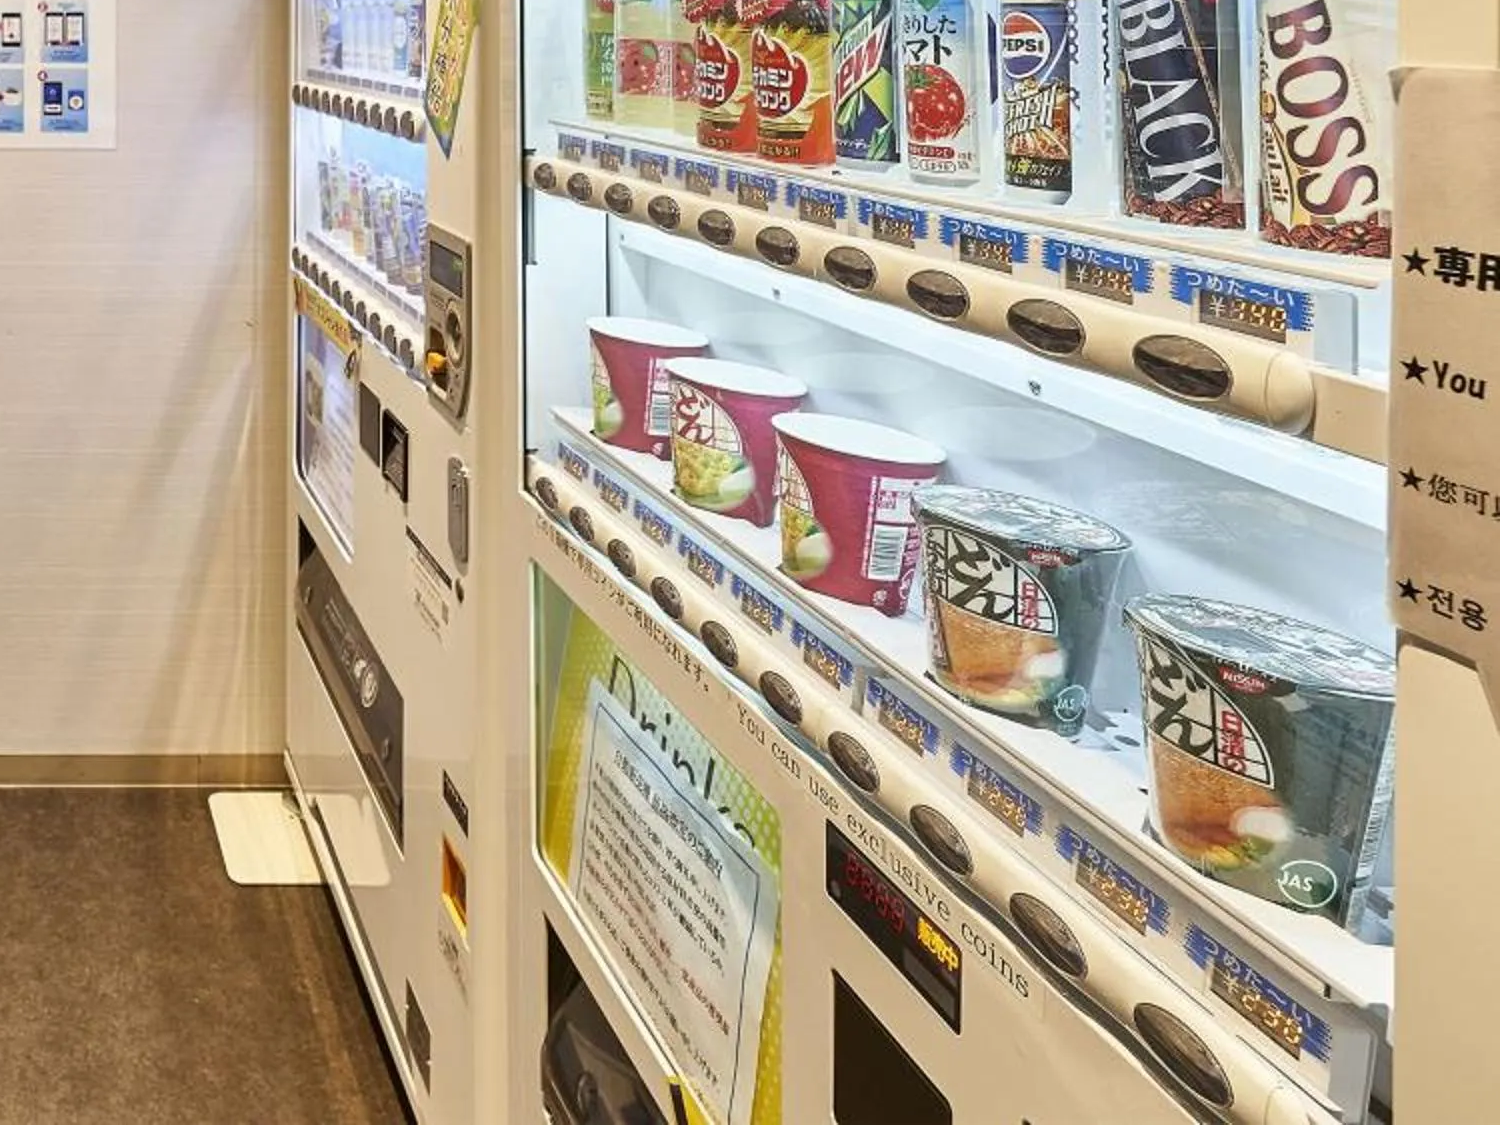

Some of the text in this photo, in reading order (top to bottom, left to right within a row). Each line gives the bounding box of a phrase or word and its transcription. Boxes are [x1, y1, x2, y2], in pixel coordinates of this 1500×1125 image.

[1432, 360, 1486, 400] You
[1426, 584, 1487, 632] 전용
[737, 705, 765, 745] You
[771, 744, 801, 779] can
[807, 778, 840, 815] use
[846, 811, 951, 921] exclusive
[960, 922, 1030, 998] coins
[1277, 871, 1313, 892] JAS
